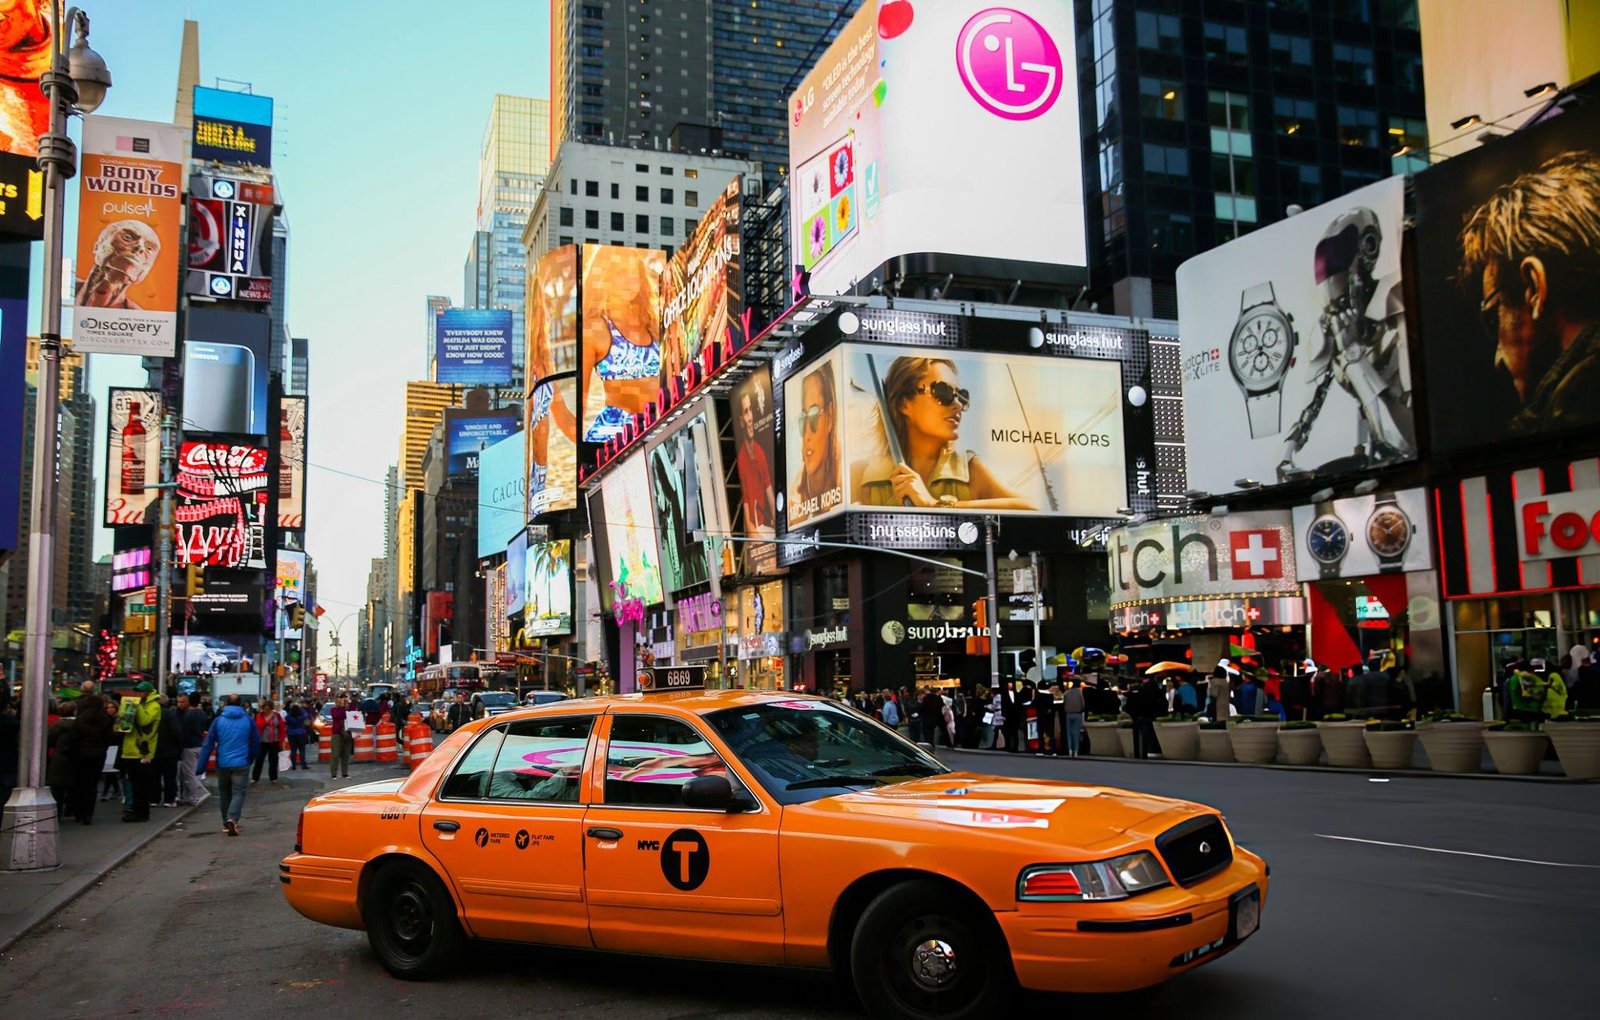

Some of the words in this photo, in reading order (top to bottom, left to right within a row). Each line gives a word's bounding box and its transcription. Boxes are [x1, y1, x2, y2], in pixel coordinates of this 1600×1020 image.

[962, 13, 1057, 114] LG
[803, 85, 815, 114] LG
[101, 164, 163, 182] BODY
[86, 177, 178, 199] WORLDS
[232, 205, 247, 272] XINHUA
[861, 317, 921, 336] sunglass
[922, 319, 947, 336] hut
[1045, 331, 1100, 350] sunglass
[1101, 333, 1123, 350] hut
[632, 306, 752, 439] BROADWAY
[991, 429, 1062, 445] MICHAEL
[1068, 432, 1111, 448] KORS
[790, 496, 820, 519] MICHAEL
[820, 486, 841, 509] KORS
[870, 524, 894, 542] hut
[896, 522, 956, 542] sunglass
[667, 670, 691, 686] 6B69
[637, 840, 660, 851] NYC
[672, 841, 699, 883] T
